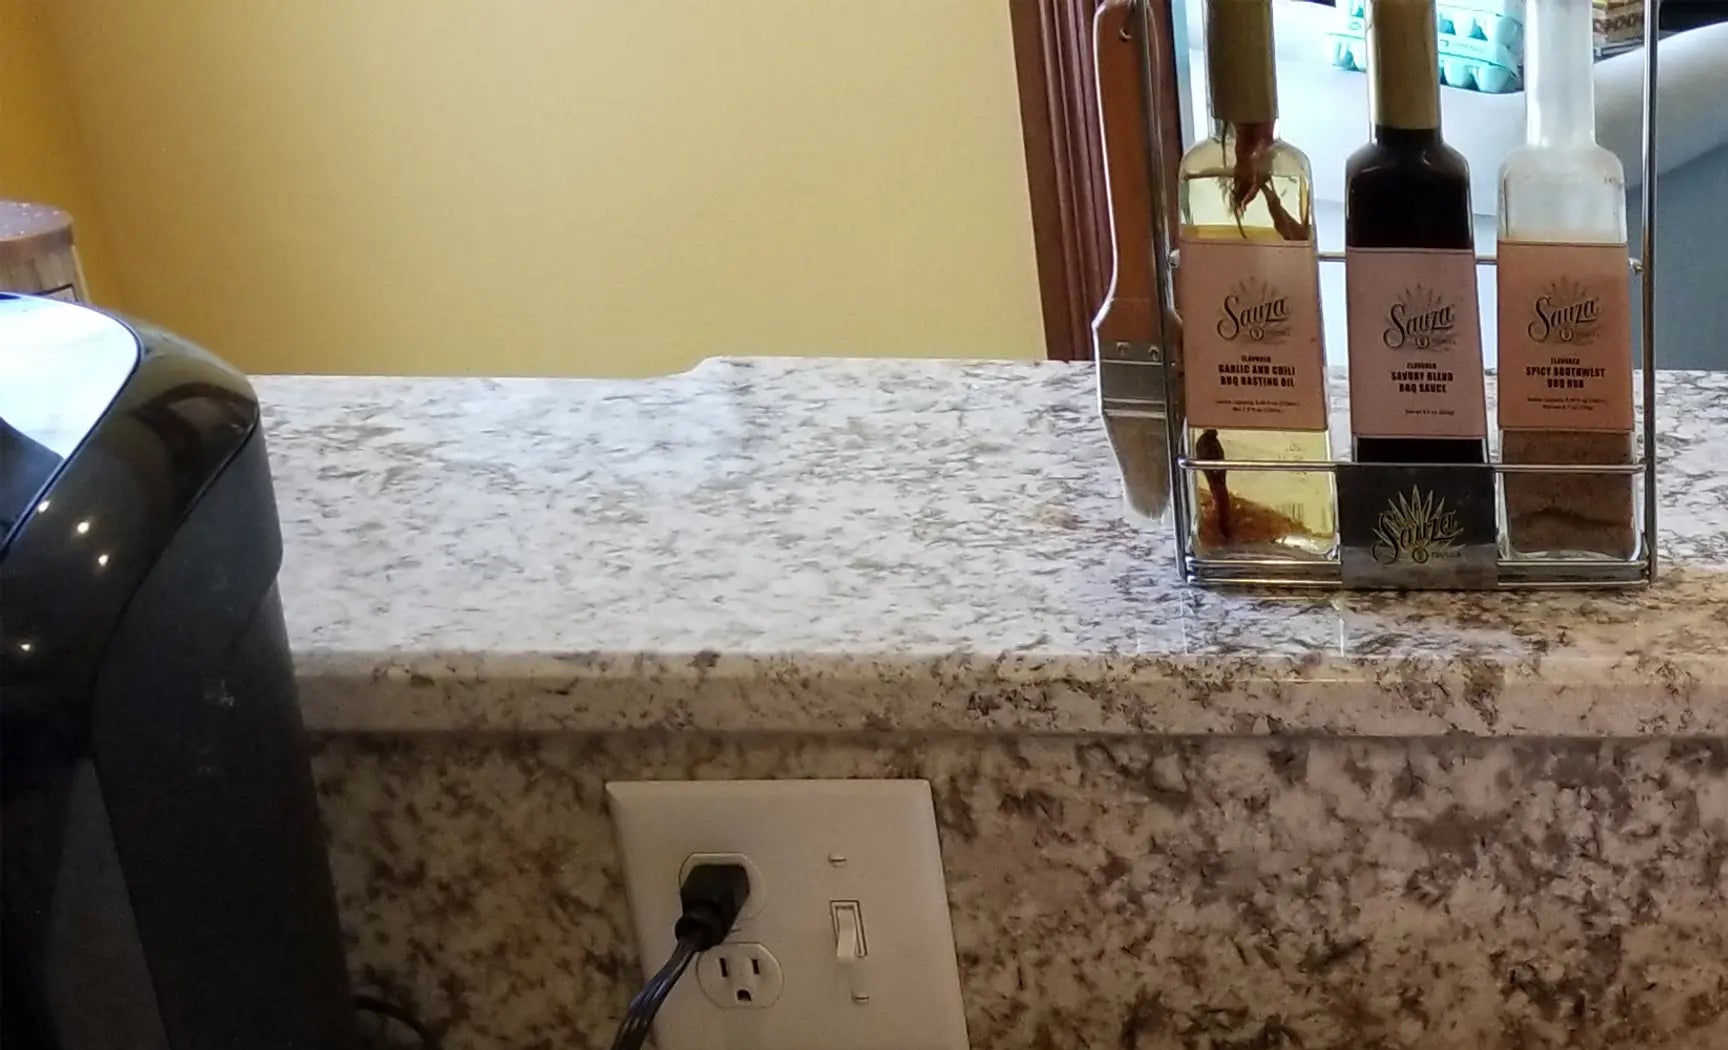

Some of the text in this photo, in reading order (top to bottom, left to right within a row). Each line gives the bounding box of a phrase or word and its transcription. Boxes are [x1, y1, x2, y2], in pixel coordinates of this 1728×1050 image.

[1217, 294, 1288, 341] Sauza
[1528, 297, 1599, 343] Sauza
[1383, 303, 1455, 350] Sauza
[1218, 364, 1296, 376] GARLIC AND CHILI
[1526, 366, 1606, 378] SPICY SOUTHWEST
[1220, 375, 1295, 388] BBQ BASTING OIL
[1391, 371, 1454, 382] SAVORY BLEND
[1399, 383, 1447, 394] BBQ SAUCE
[1547, 378, 1584, 389] BBQ RUB
[1370, 509, 1458, 565] Sauza
